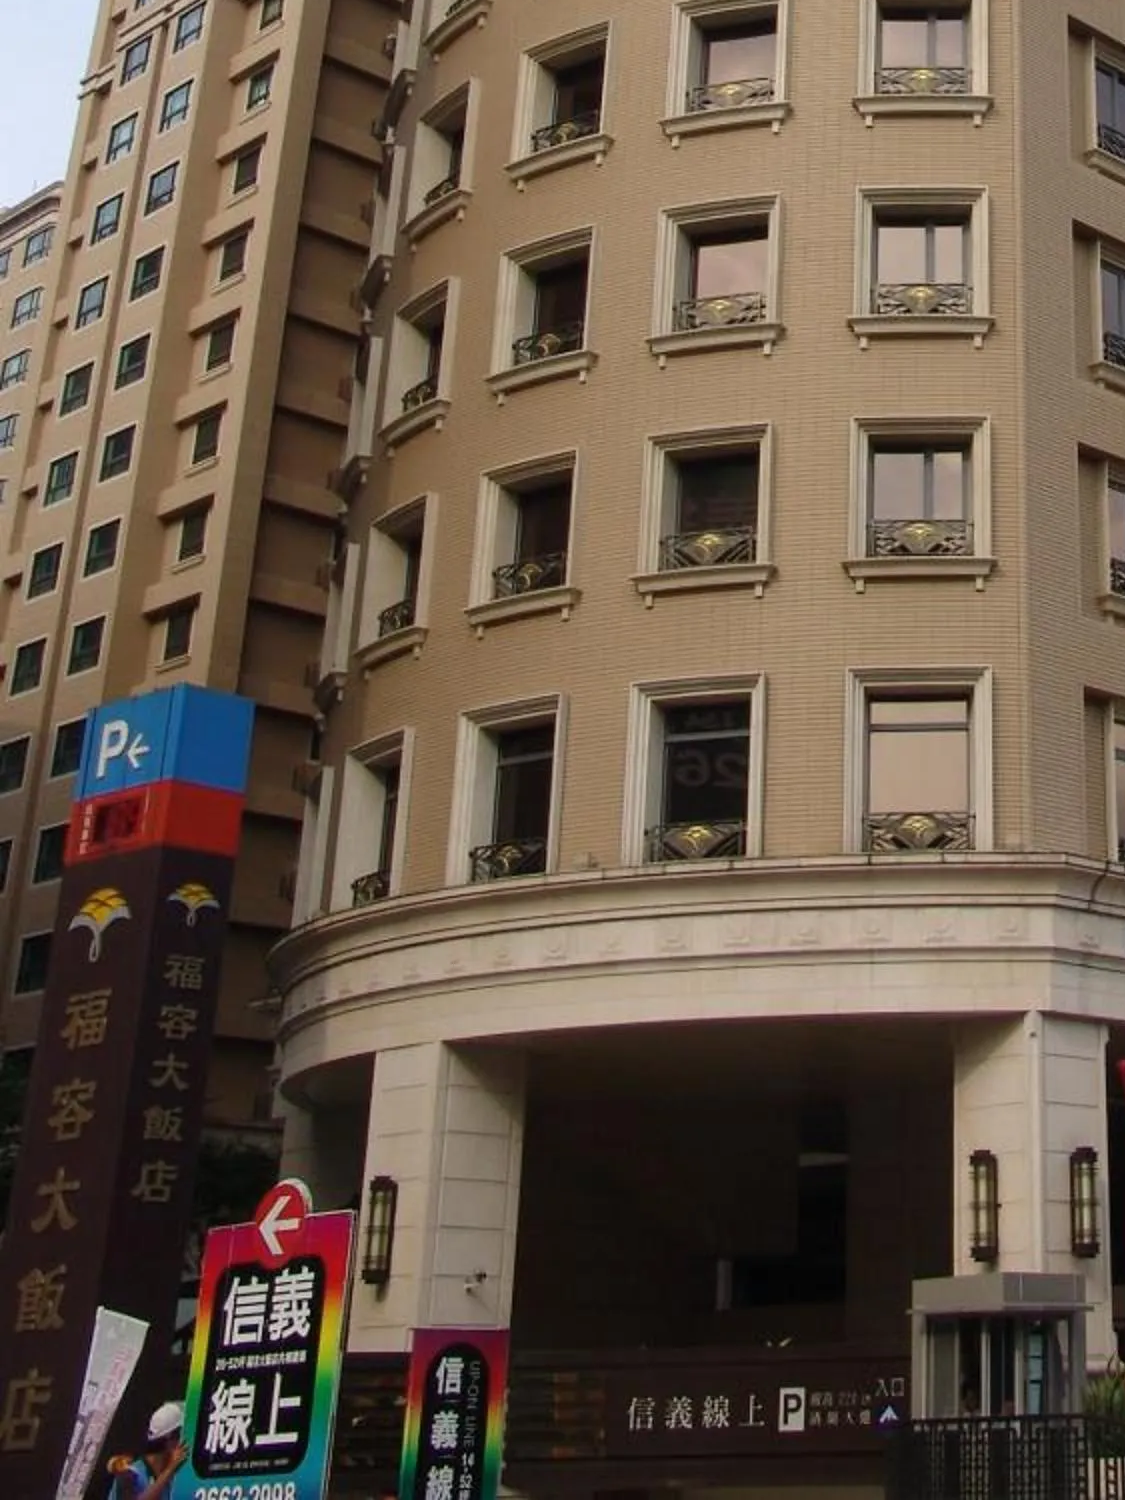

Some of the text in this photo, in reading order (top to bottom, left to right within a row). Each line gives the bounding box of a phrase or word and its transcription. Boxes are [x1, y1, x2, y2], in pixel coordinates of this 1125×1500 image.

[96, 720, 128, 779] P
[131, 954, 205, 1202] 福容大飯店
[1, 987, 112, 1451] 福容大飯店
[223, 1264, 315, 1346] 信義
[205, 1372, 302, 1454] 線上
[627, 1394, 765, 1431] 信義線上
